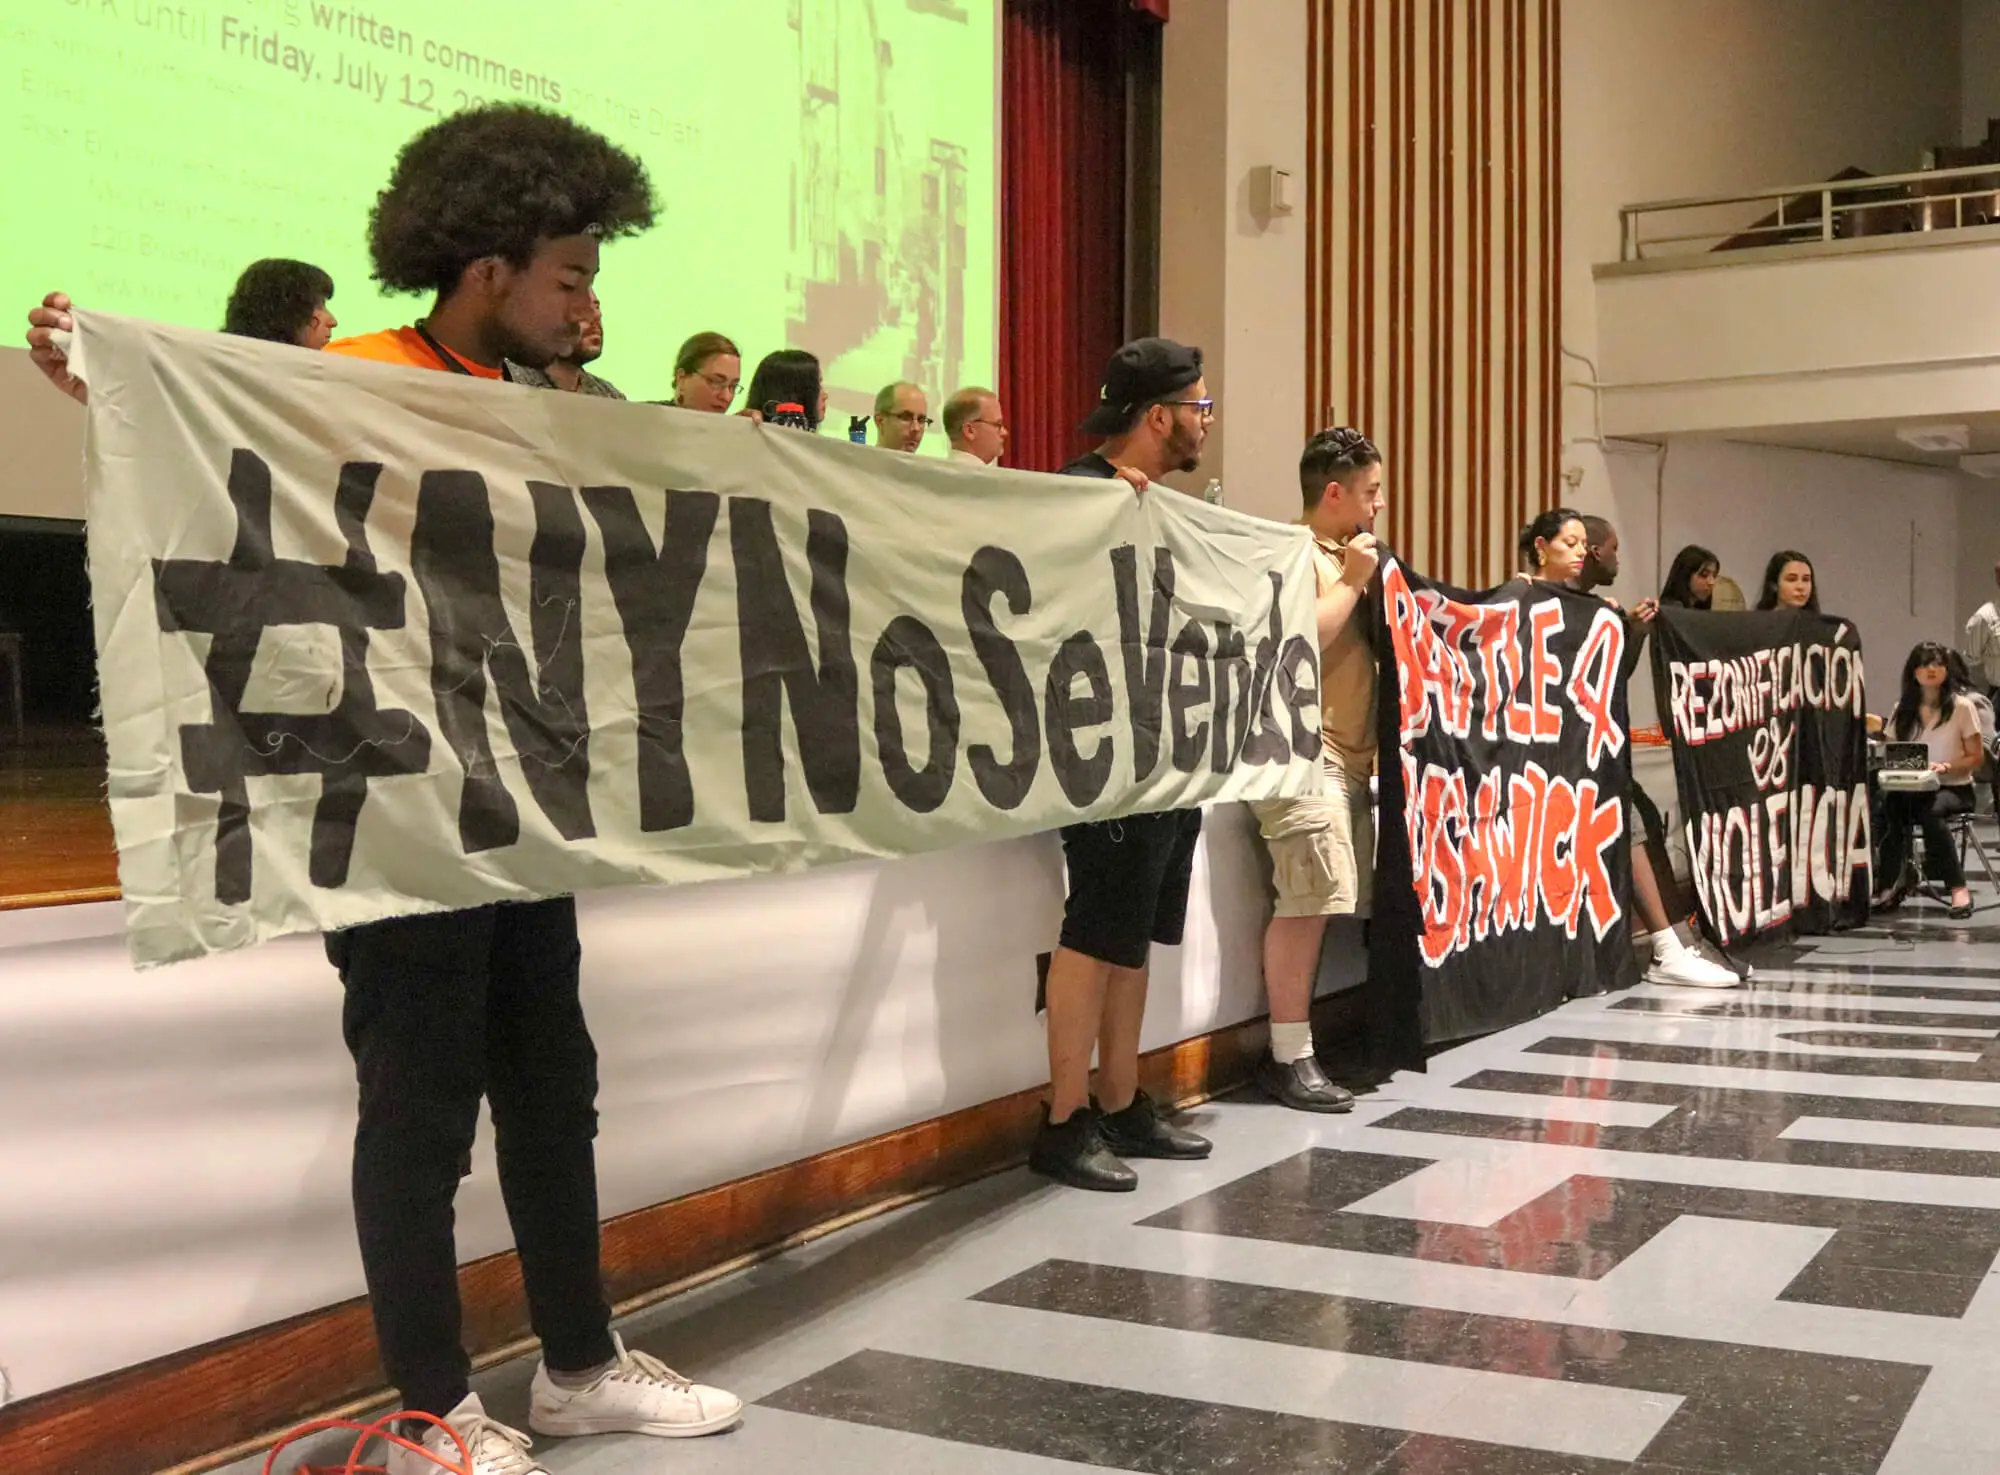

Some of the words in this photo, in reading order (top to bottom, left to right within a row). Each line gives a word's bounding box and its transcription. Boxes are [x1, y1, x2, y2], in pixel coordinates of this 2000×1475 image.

[134, 0, 207, 45] until
[333, 52, 389, 104] July
[309, 0, 413, 57] written
[424, 39, 562, 103] comments
[151, 447, 1323, 904] #NYNoSeVende
[1383, 557, 1567, 745] BATTLE
